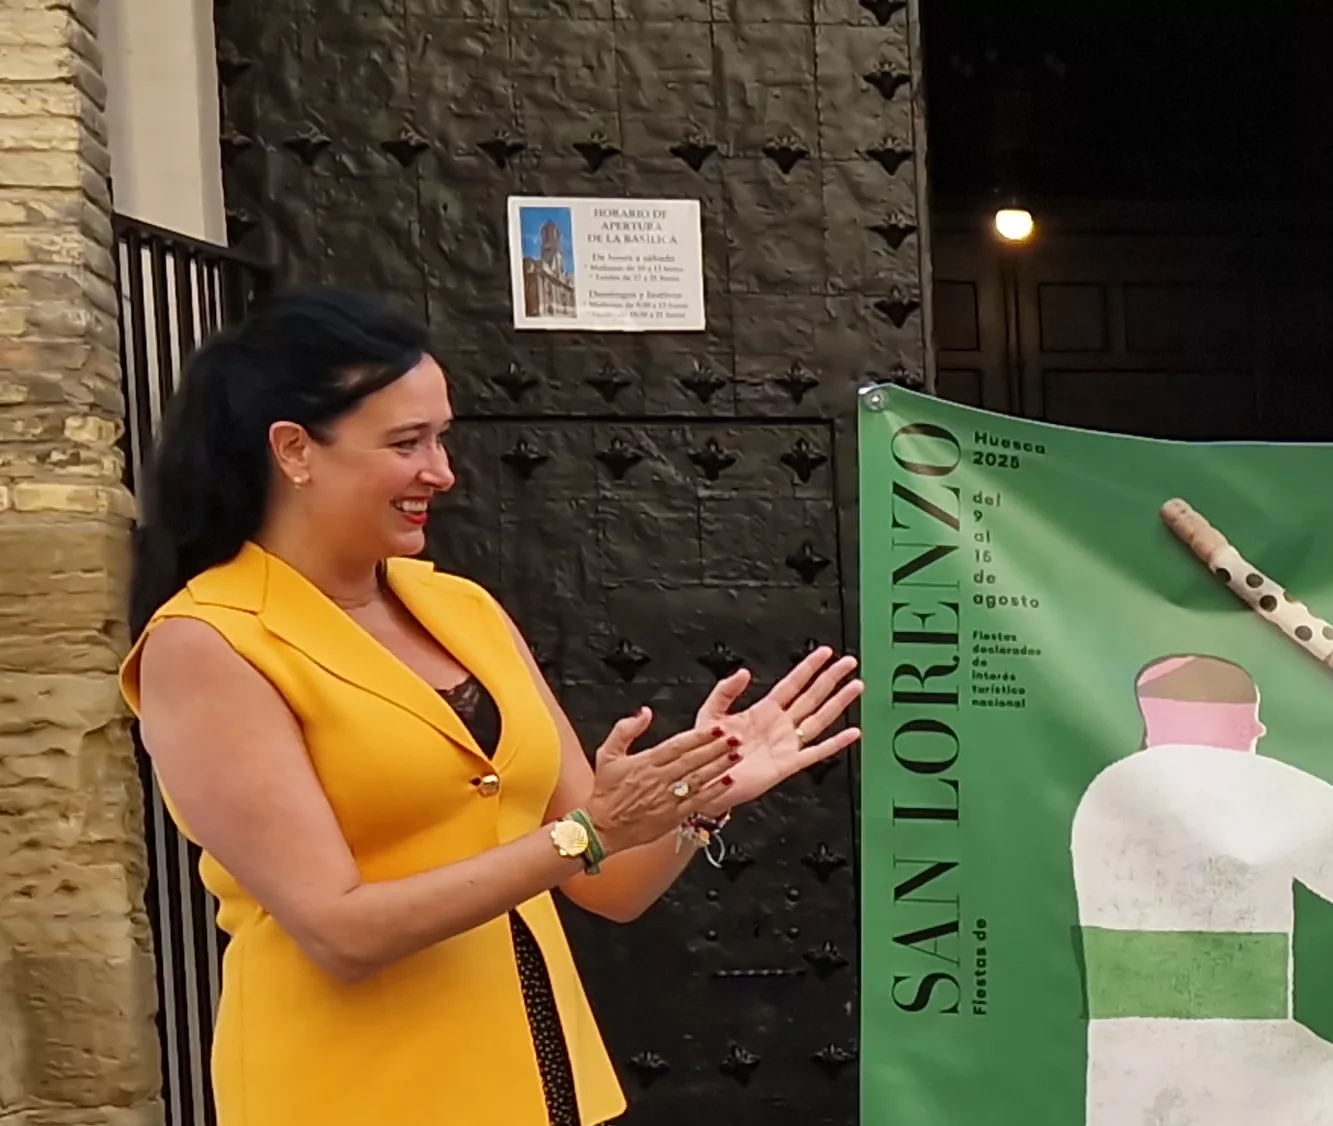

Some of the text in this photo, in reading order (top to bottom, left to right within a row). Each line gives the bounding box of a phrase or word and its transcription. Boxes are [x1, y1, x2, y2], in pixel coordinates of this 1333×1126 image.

[594, 208, 650, 218] HORARIO
[601, 221, 663, 231] APERTURA
[587, 233, 603, 243] DE
[605, 234, 621, 244] LA
[975, 431, 1046, 455] Huesca
[973, 451, 1020, 470] 2025
[973, 490, 1001, 507] del
[973, 510, 983, 522] 9
[974, 529, 990, 543] al
[973, 569, 996, 584] de
[973, 594, 1040, 609] agosto
[972, 630, 1017, 642] Fiestas
[972, 656, 987, 667] de
[891, 422, 962, 1014] SAN LORENZO
[972, 918, 988, 1016] Fiestas de
